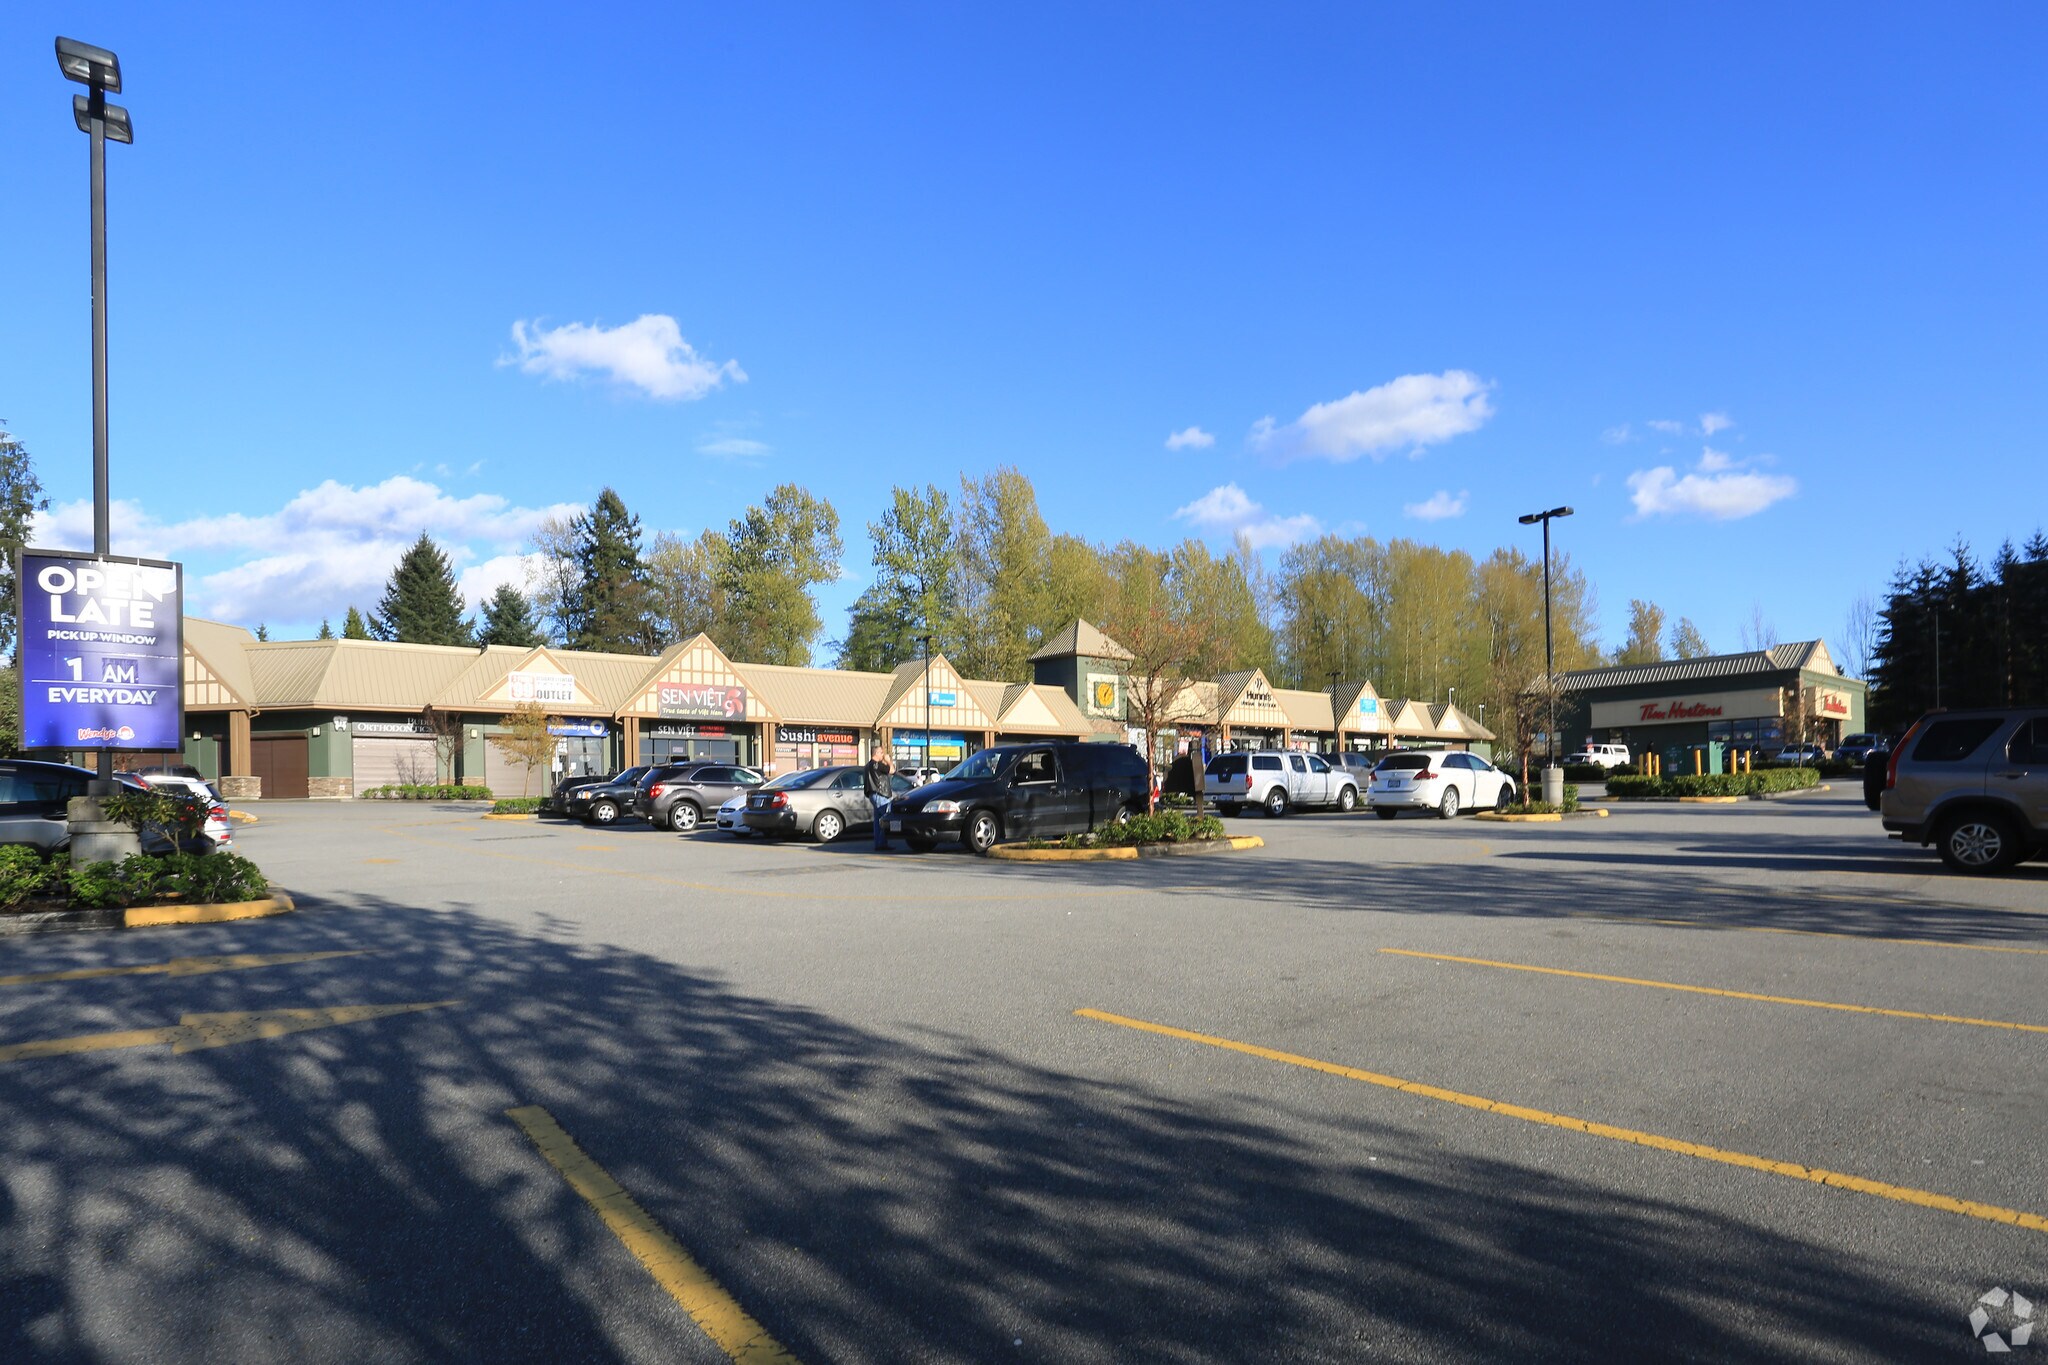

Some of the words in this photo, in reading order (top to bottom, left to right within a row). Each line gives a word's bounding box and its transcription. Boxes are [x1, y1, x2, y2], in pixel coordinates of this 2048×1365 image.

[38, 566, 163, 602] OPEN
[50, 595, 155, 629] LATE
[47, 629, 79, 641] PICK
[80, 631, 99, 642] UP
[99, 633, 157, 646] WINDOW
[66, 657, 83, 682] 1
[102, 665, 136, 684] AM
[48, 687, 157, 705] EVERYDAY
[536, 689, 573, 701] OUTLET
[661, 688, 690, 705] SEN
[1640, 703, 1666, 721] Tim
[1666, 701, 1723, 719] Hortons
[78, 727, 116, 741] Wendy's
[657, 725, 675, 735] SEN
[779, 728, 816, 742] Sushi
[817, 733, 853, 743] avenue
